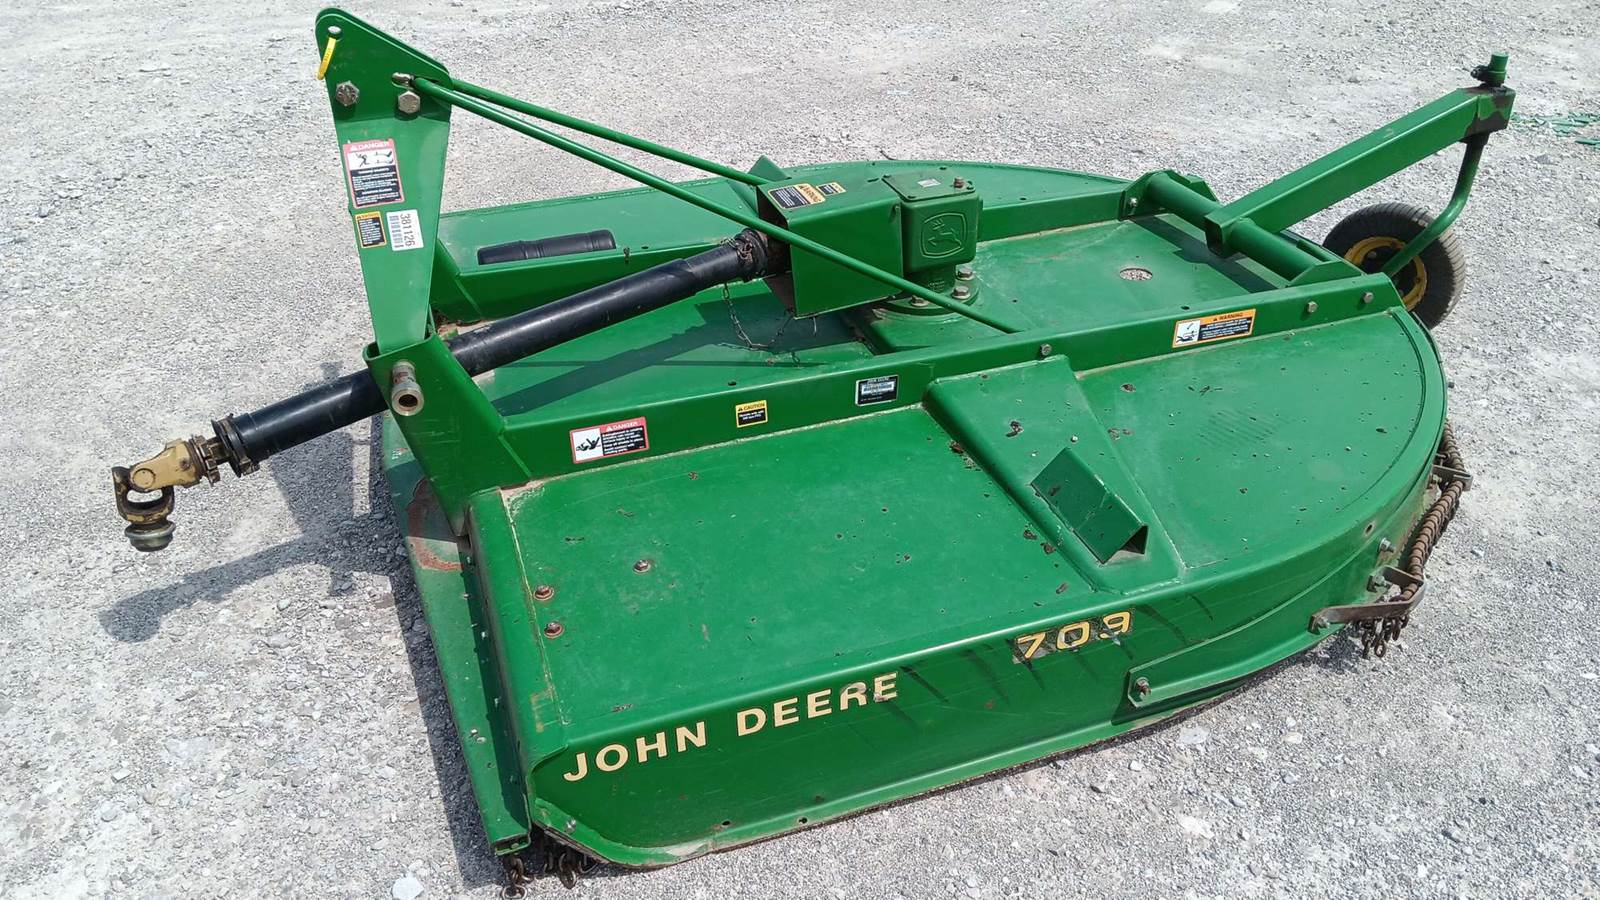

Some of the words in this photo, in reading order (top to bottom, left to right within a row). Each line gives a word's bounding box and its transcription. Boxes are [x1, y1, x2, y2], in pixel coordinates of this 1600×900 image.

[358, 141, 390, 150] DANGER
[400, 213, 416, 247] 381126
[743, 402, 765, 411] CAUTION
[613, 421, 639, 430] DANGER
[1017, 611, 1132, 660] 709
[563, 721, 707, 782] JOHN
[736, 672, 898, 737] DEERE
